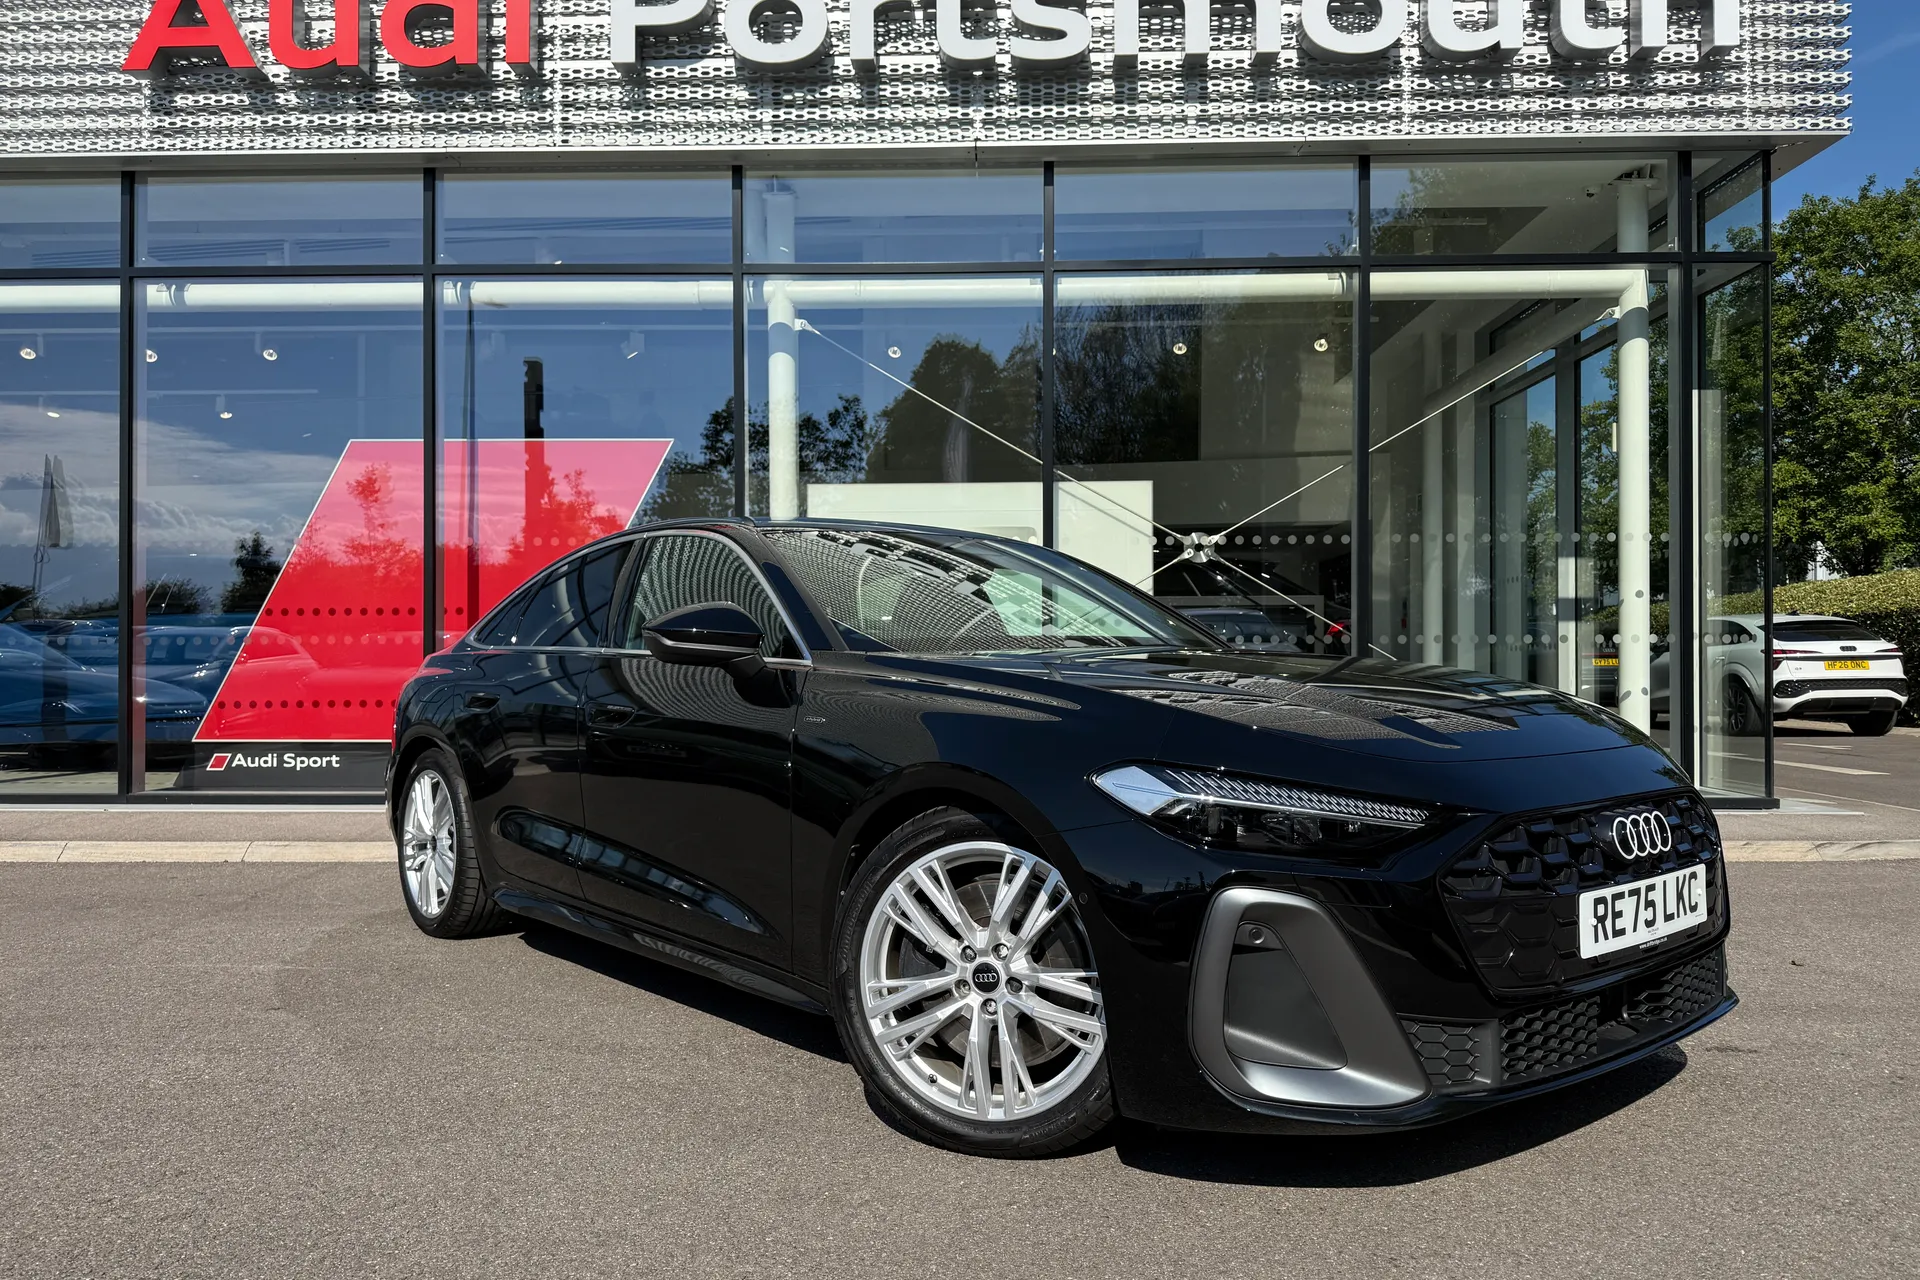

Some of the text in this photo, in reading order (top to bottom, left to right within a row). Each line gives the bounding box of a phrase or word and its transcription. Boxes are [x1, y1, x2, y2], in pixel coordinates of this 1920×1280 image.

[122, 0, 1740, 70] Audi Portsmouth
[231, 753, 340, 771] Audi Sport
[1593, 871, 1699, 944] RE75 LKC
